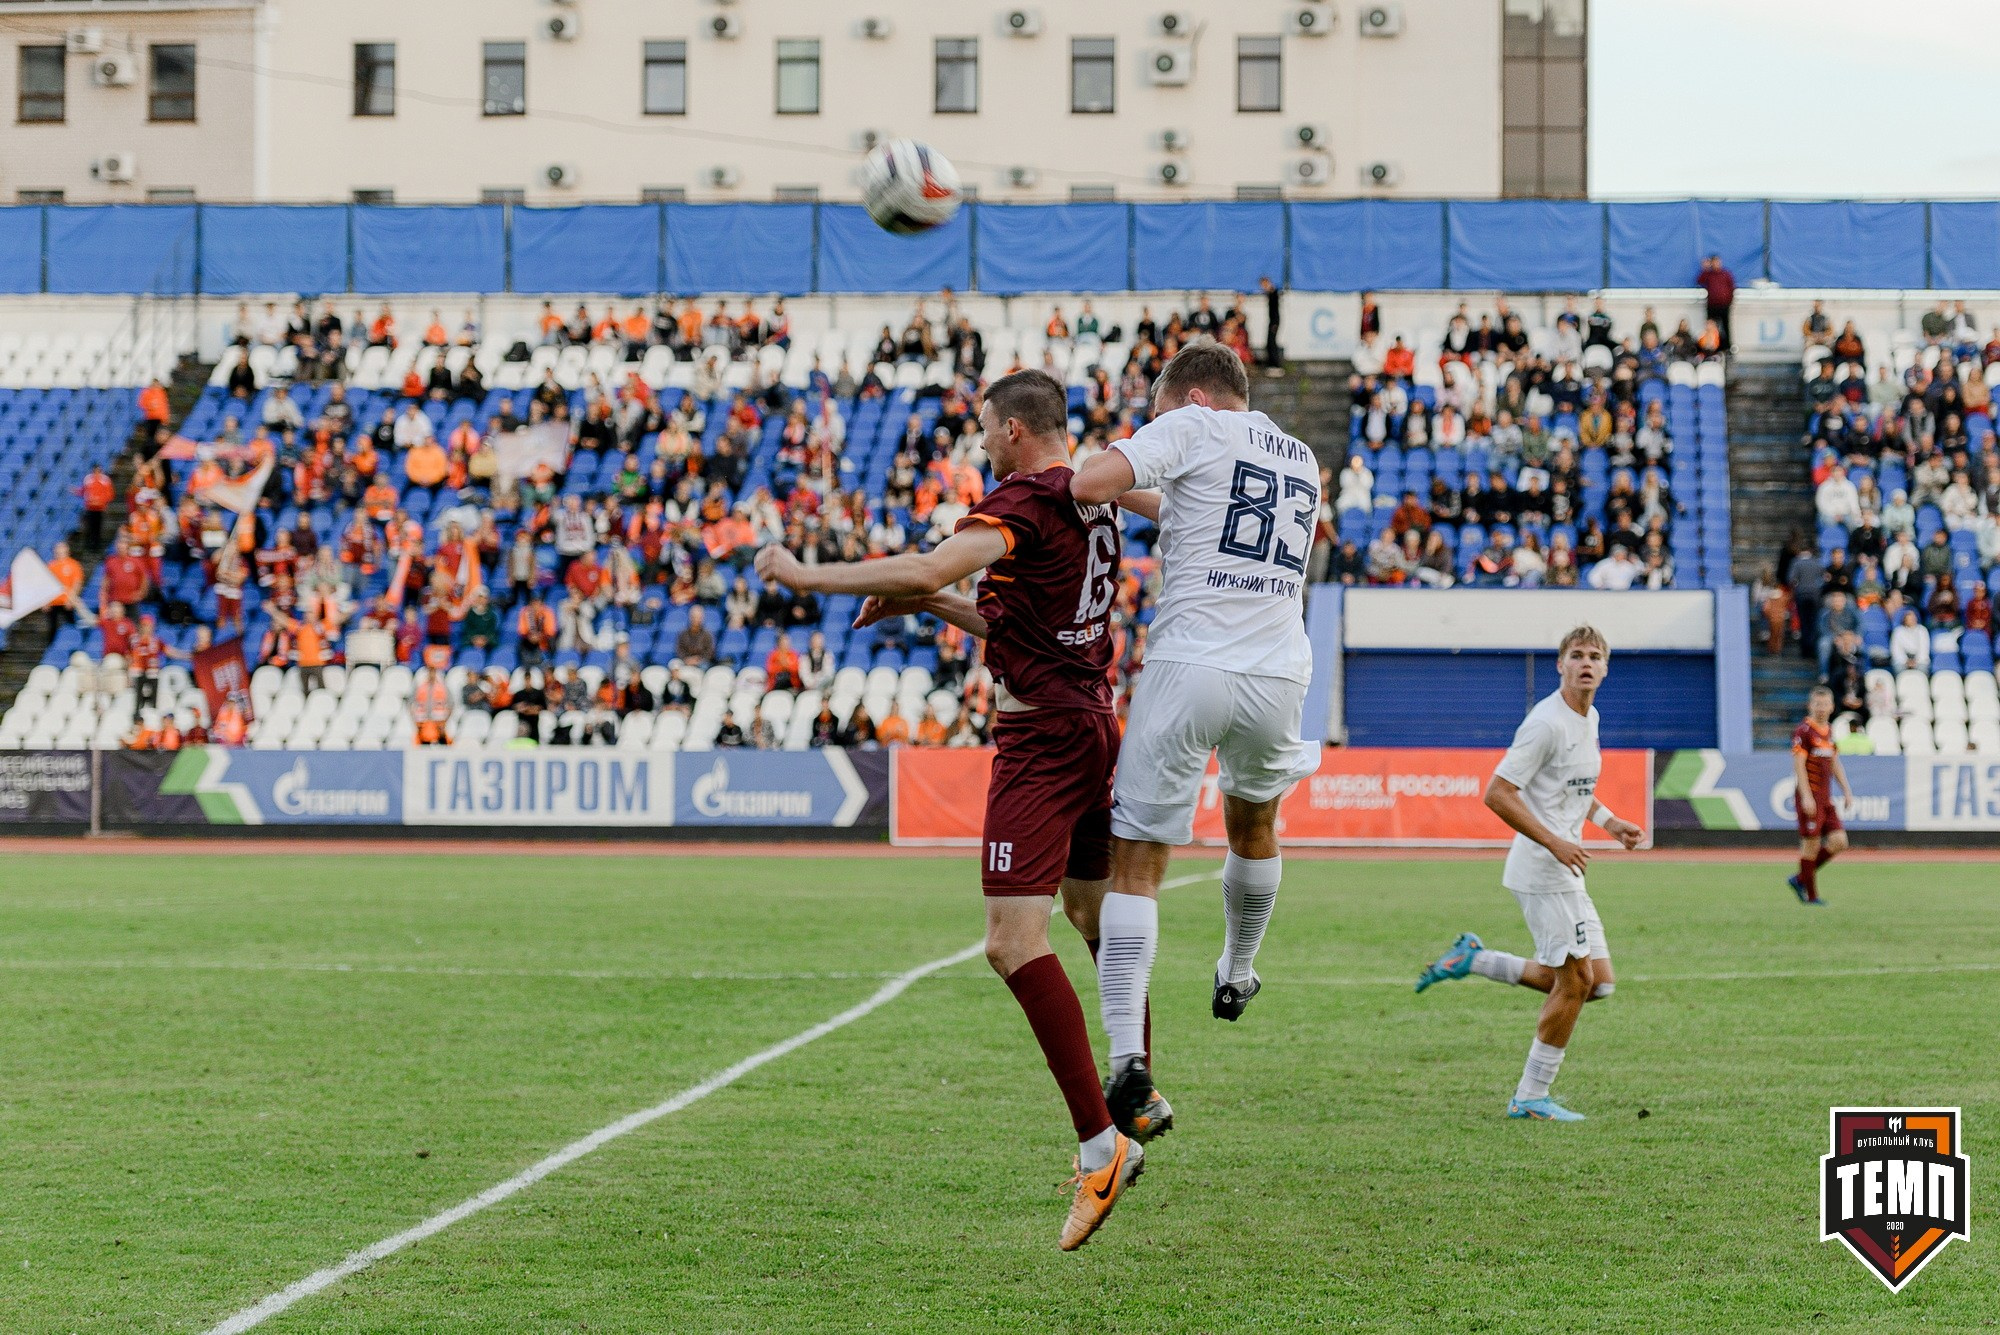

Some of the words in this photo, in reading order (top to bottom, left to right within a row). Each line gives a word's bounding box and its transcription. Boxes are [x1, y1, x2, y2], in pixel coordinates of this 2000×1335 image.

[1249, 427, 1308, 463] ГЕЙКИН
[1218, 460, 1318, 577] 83
[1207, 569, 1268, 593] НИЖНИЙ
[427, 760, 650, 814] ГАЗПРОМ
[989, 841, 1013, 872] 15
[1575, 921, 1587, 945] 5
